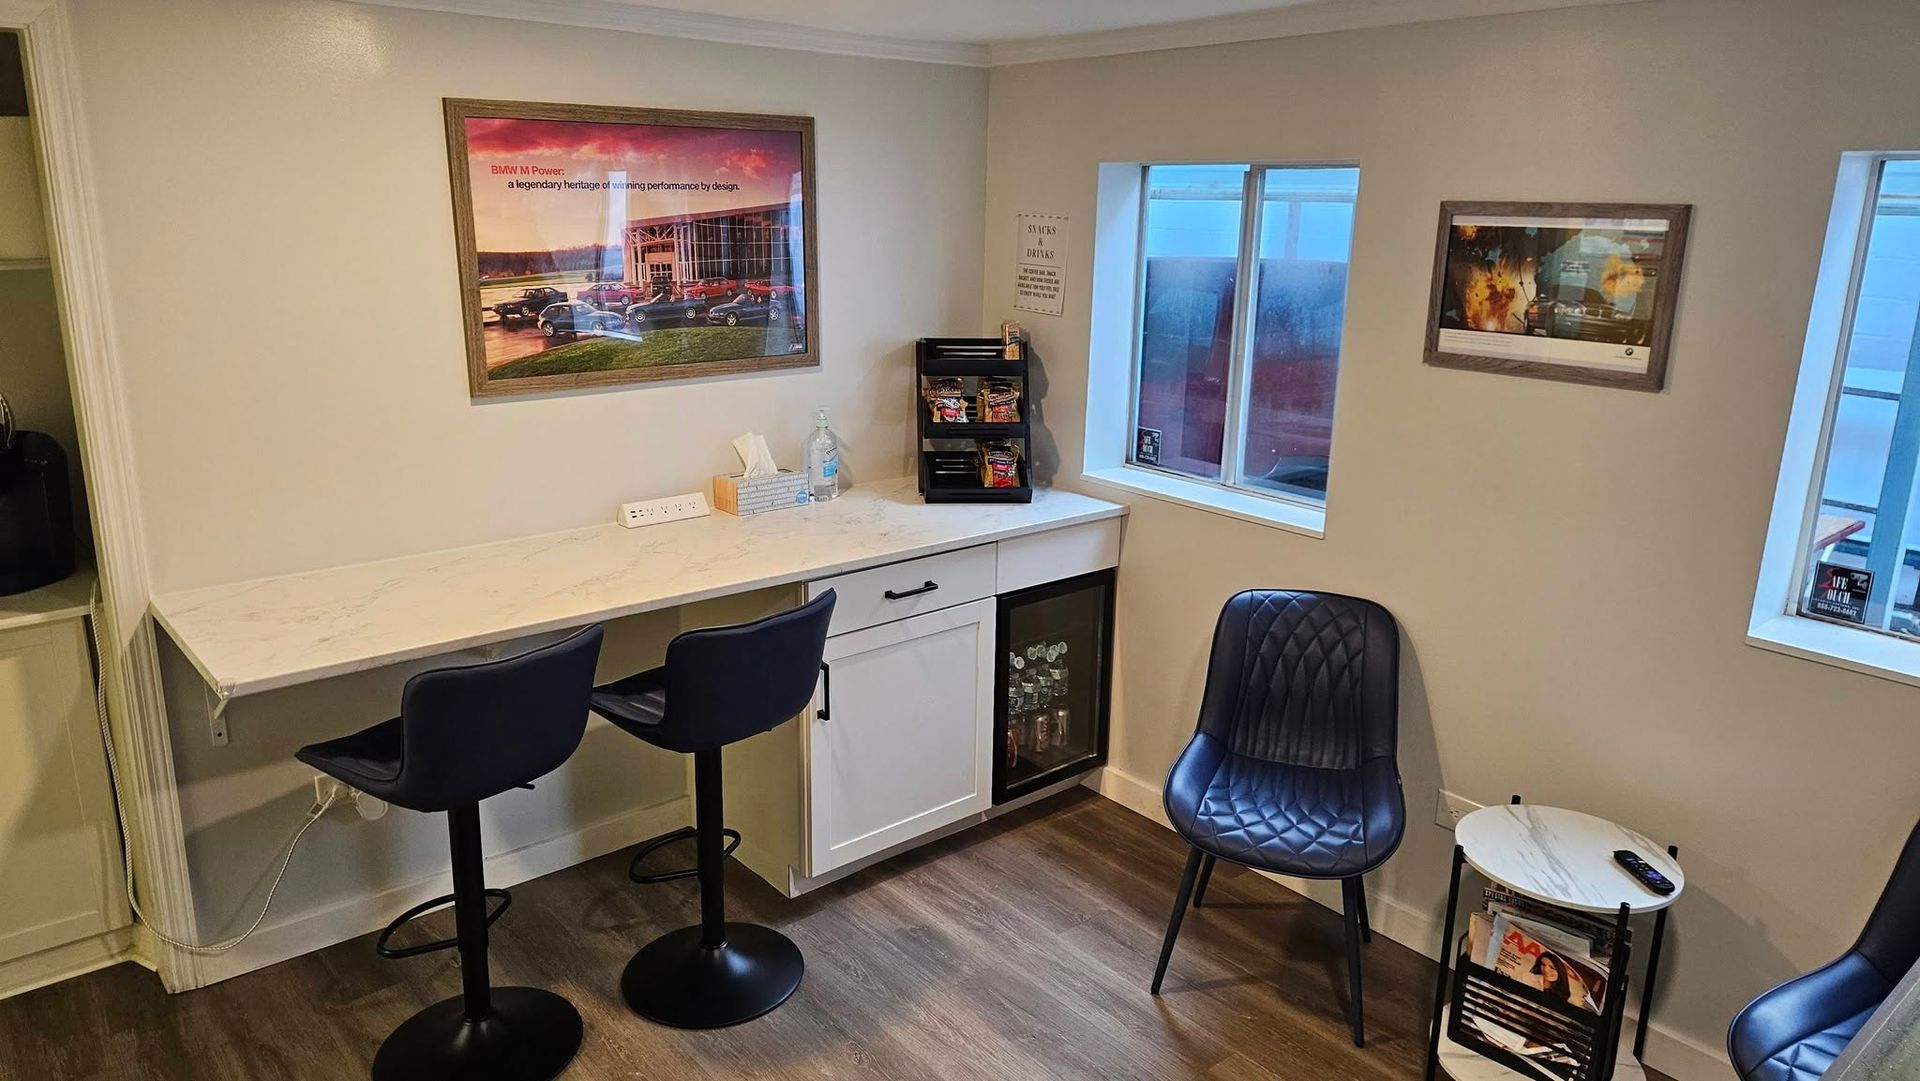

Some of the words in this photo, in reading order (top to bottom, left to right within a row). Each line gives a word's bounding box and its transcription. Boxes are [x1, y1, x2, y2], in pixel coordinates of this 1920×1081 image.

[491, 165, 517, 175] BMW
[520, 166, 529, 175] M
[531, 167, 565, 176] Power:
[508, 181, 514, 189] a
[516, 180, 562, 191] legendary
[564, 180, 600, 191] heritage
[602, 181, 611, 190] of
[612, 181, 645, 191] winning
[647, 181, 699, 192] performance
[701, 182, 711, 192] by
[712, 182, 740, 192] design.
[1027, 224, 1056, 235] SNACKS
[1027, 248, 1054, 259] DRINKS
